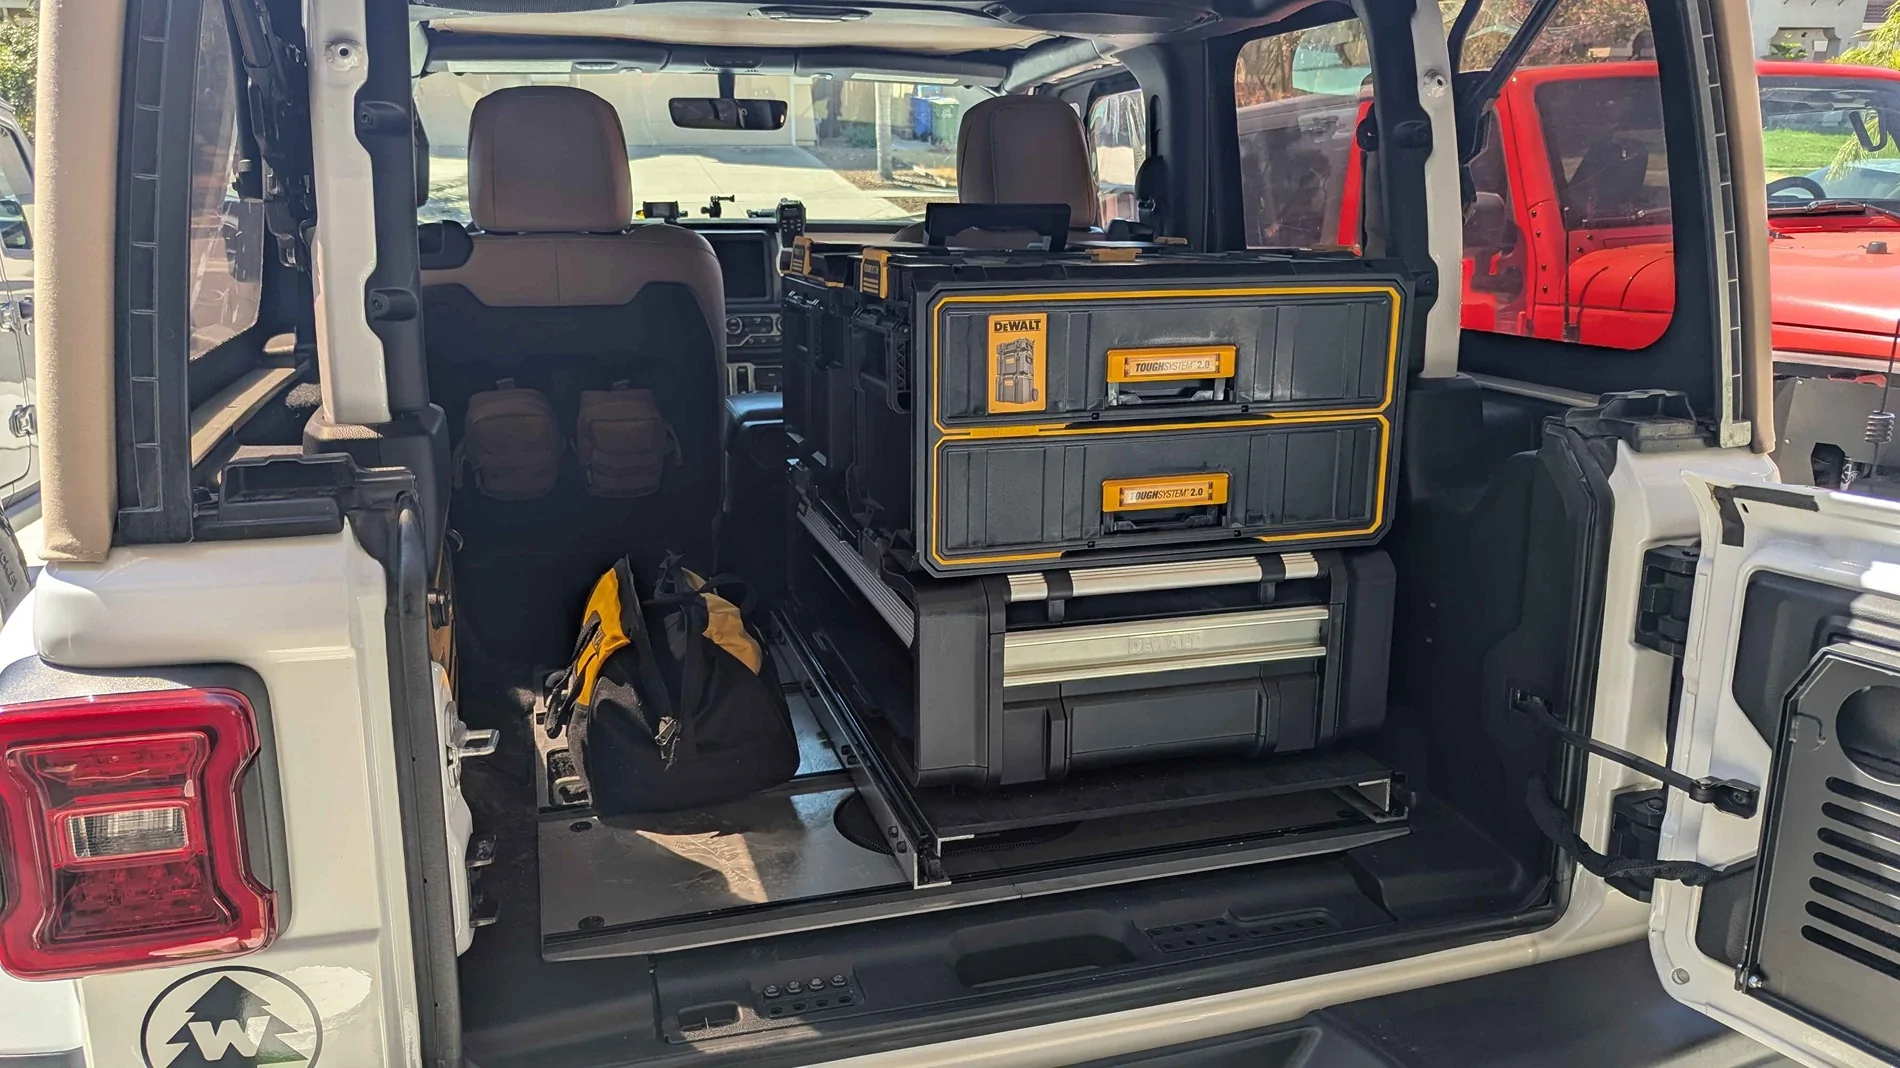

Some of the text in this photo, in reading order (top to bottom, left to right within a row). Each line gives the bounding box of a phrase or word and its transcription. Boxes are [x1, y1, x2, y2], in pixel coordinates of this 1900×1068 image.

[1197, 360, 1210, 370] 2.0
[1190, 487, 1203, 497] 2.0
[188, 1015, 271, 1061] W
